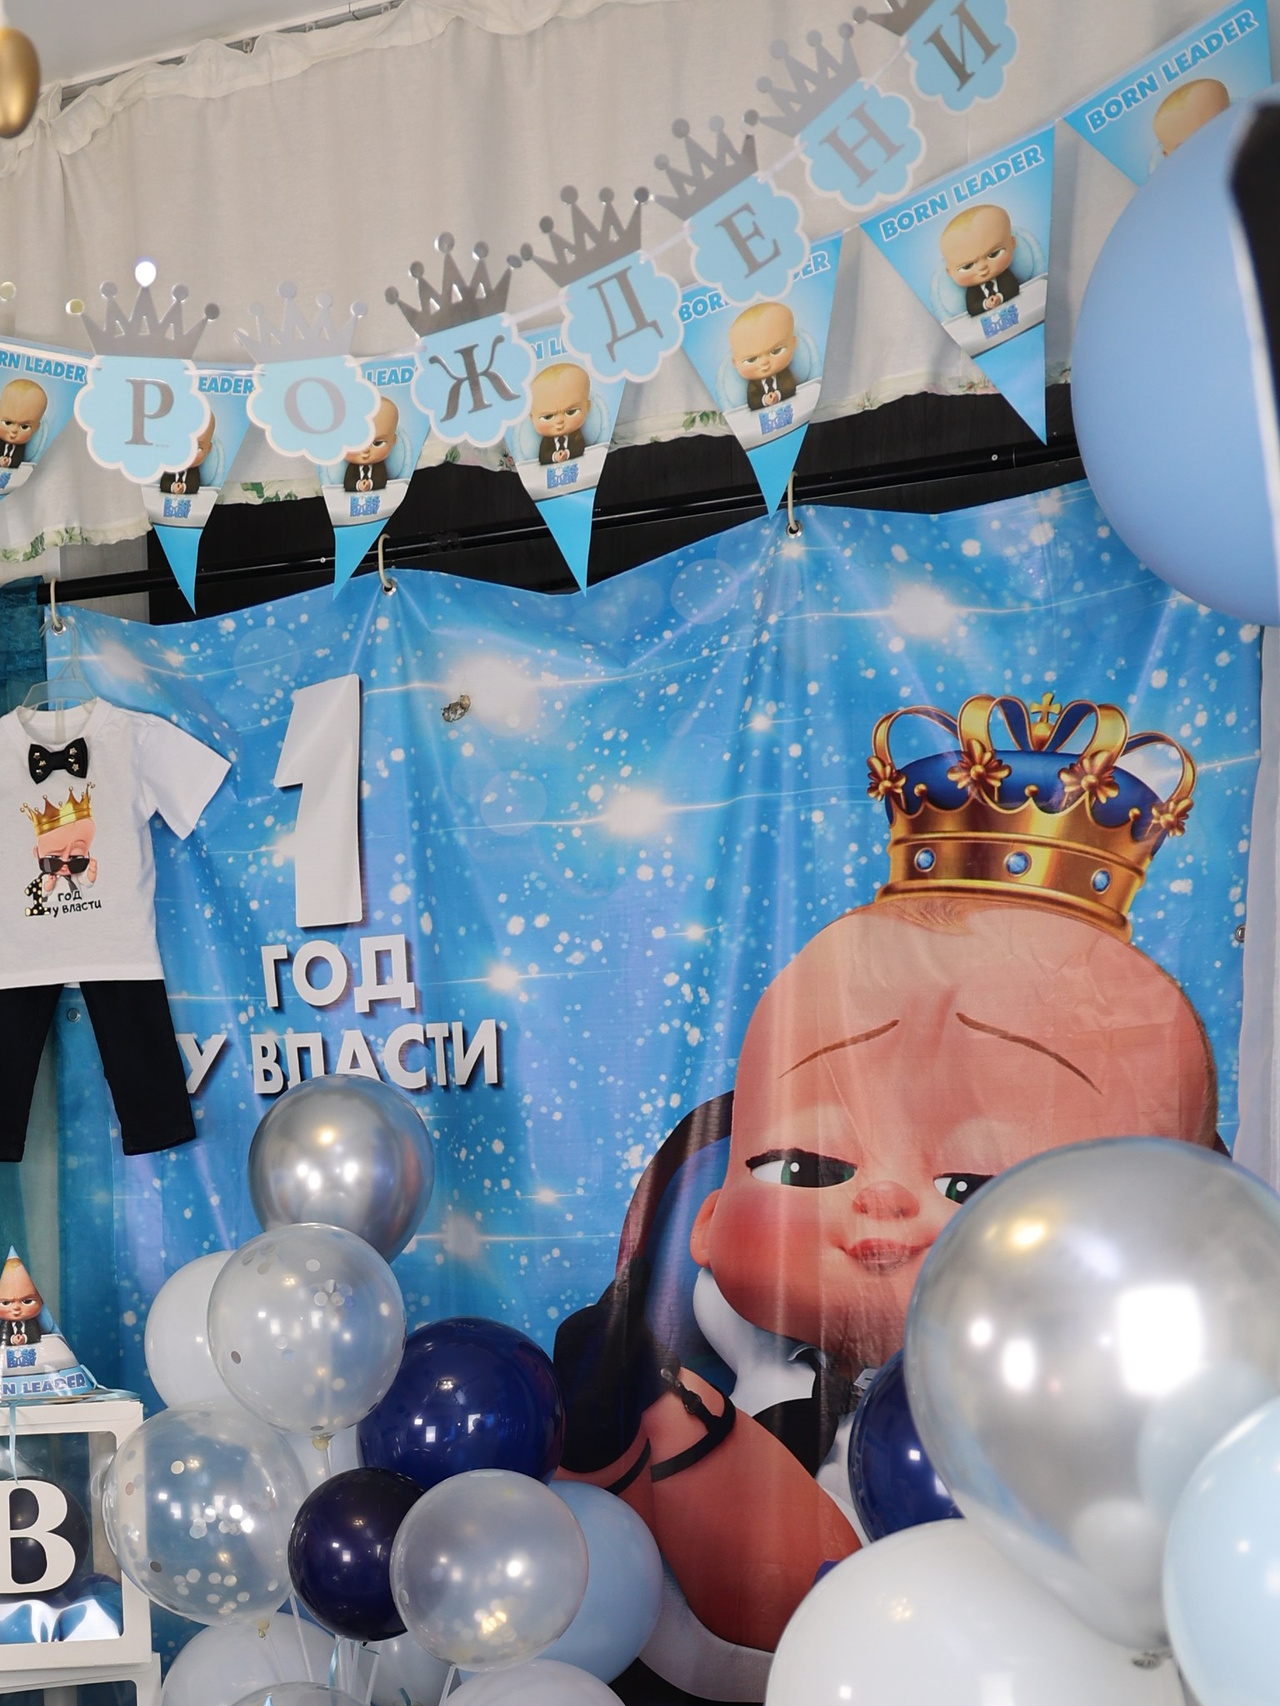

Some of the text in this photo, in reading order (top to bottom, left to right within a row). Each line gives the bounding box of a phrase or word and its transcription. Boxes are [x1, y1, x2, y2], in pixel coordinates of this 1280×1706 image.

[1086, 9, 1260, 133] BORN LEADER
[880, 144, 1046, 241] BORN LEADER
[678, 290, 731, 324] BOR
[24, 358, 88, 383] LEADER
[197, 376, 254, 395] EADER
[366, 366, 418, 387] LEAD
[274, 673, 363, 928] 1
[52, 899, 102, 918] у власти
[57, 890, 83, 902] год
[260, 933, 416, 1014] ГОД
[176, 1018, 499, 1095] У ВЛАСТИ
